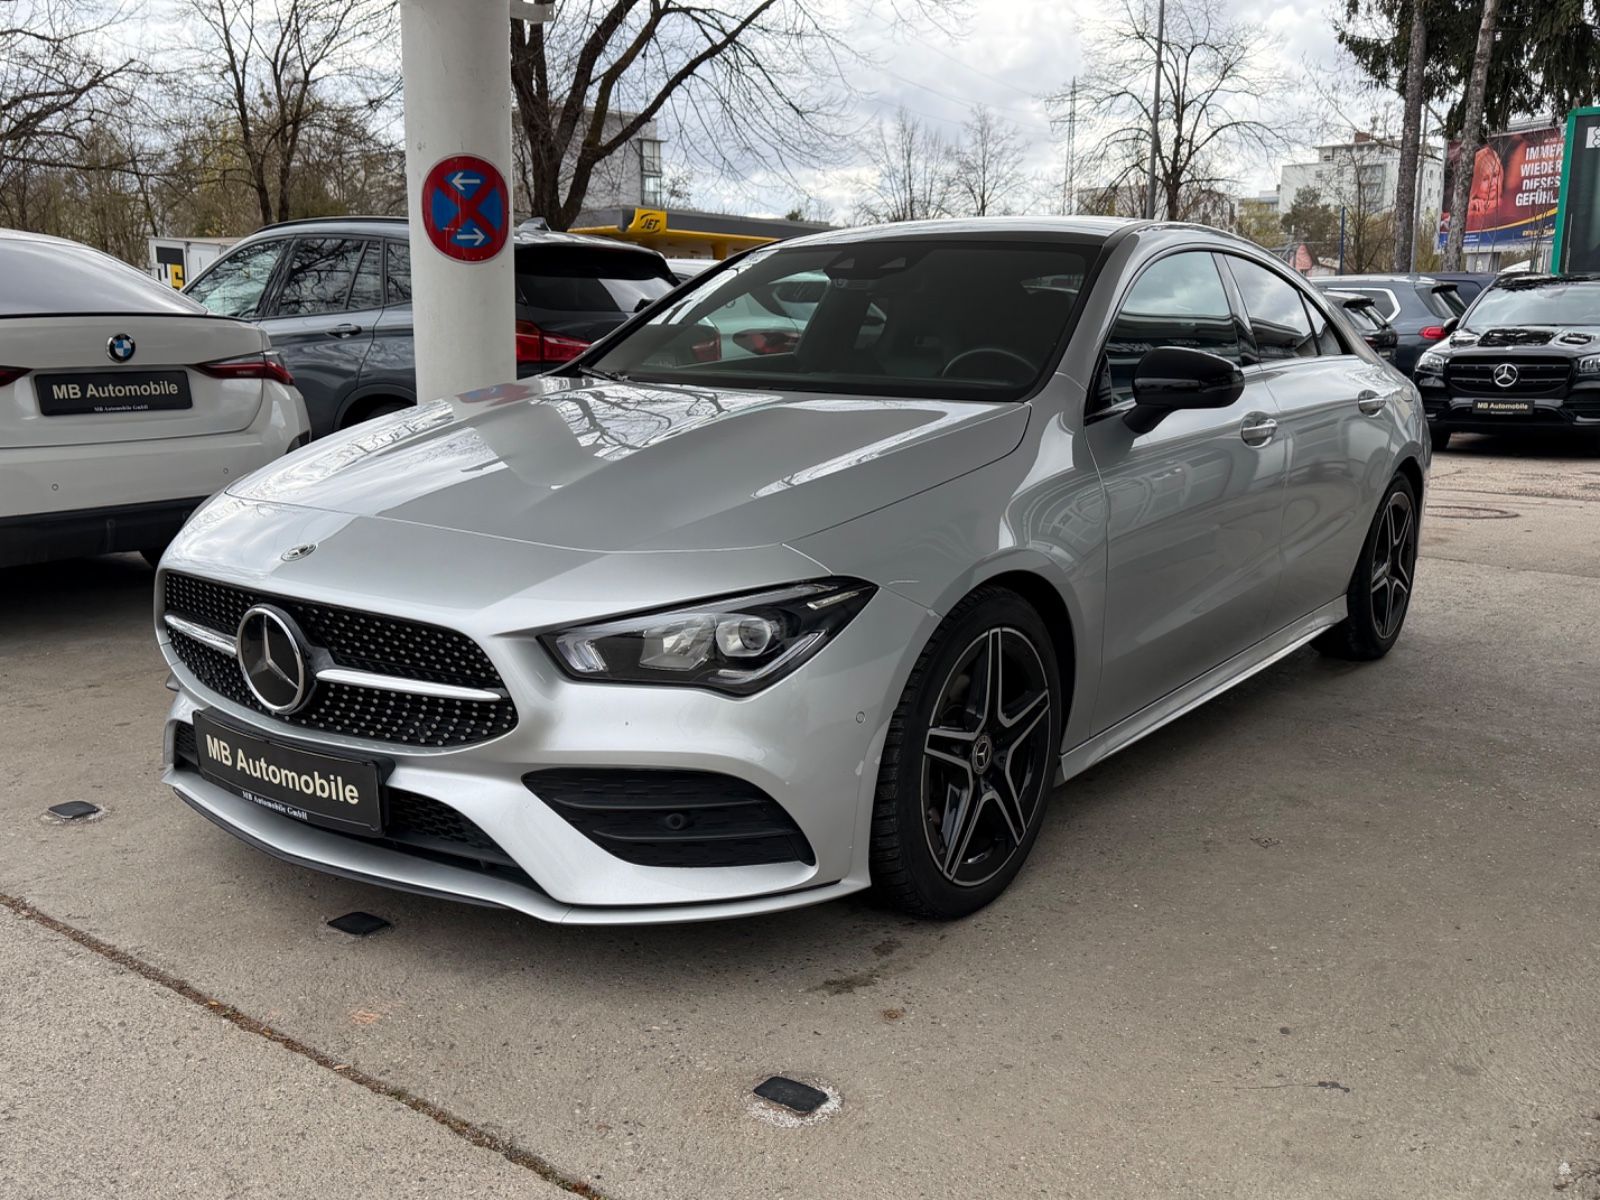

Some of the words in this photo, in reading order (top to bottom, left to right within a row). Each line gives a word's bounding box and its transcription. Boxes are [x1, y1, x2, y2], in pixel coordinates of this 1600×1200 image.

[1525, 143, 1563, 161] IMMER
[1520, 159, 1562, 177] WIEDER
[1522, 175, 1561, 190] DIESES
[641, 217, 660, 230] JET
[52, 384, 81, 399] MB
[86, 381, 178, 398] Automobile
[1490, 402, 1528, 410] Automobile
[205, 734, 232, 766] MB
[236, 748, 359, 805] Automobile
